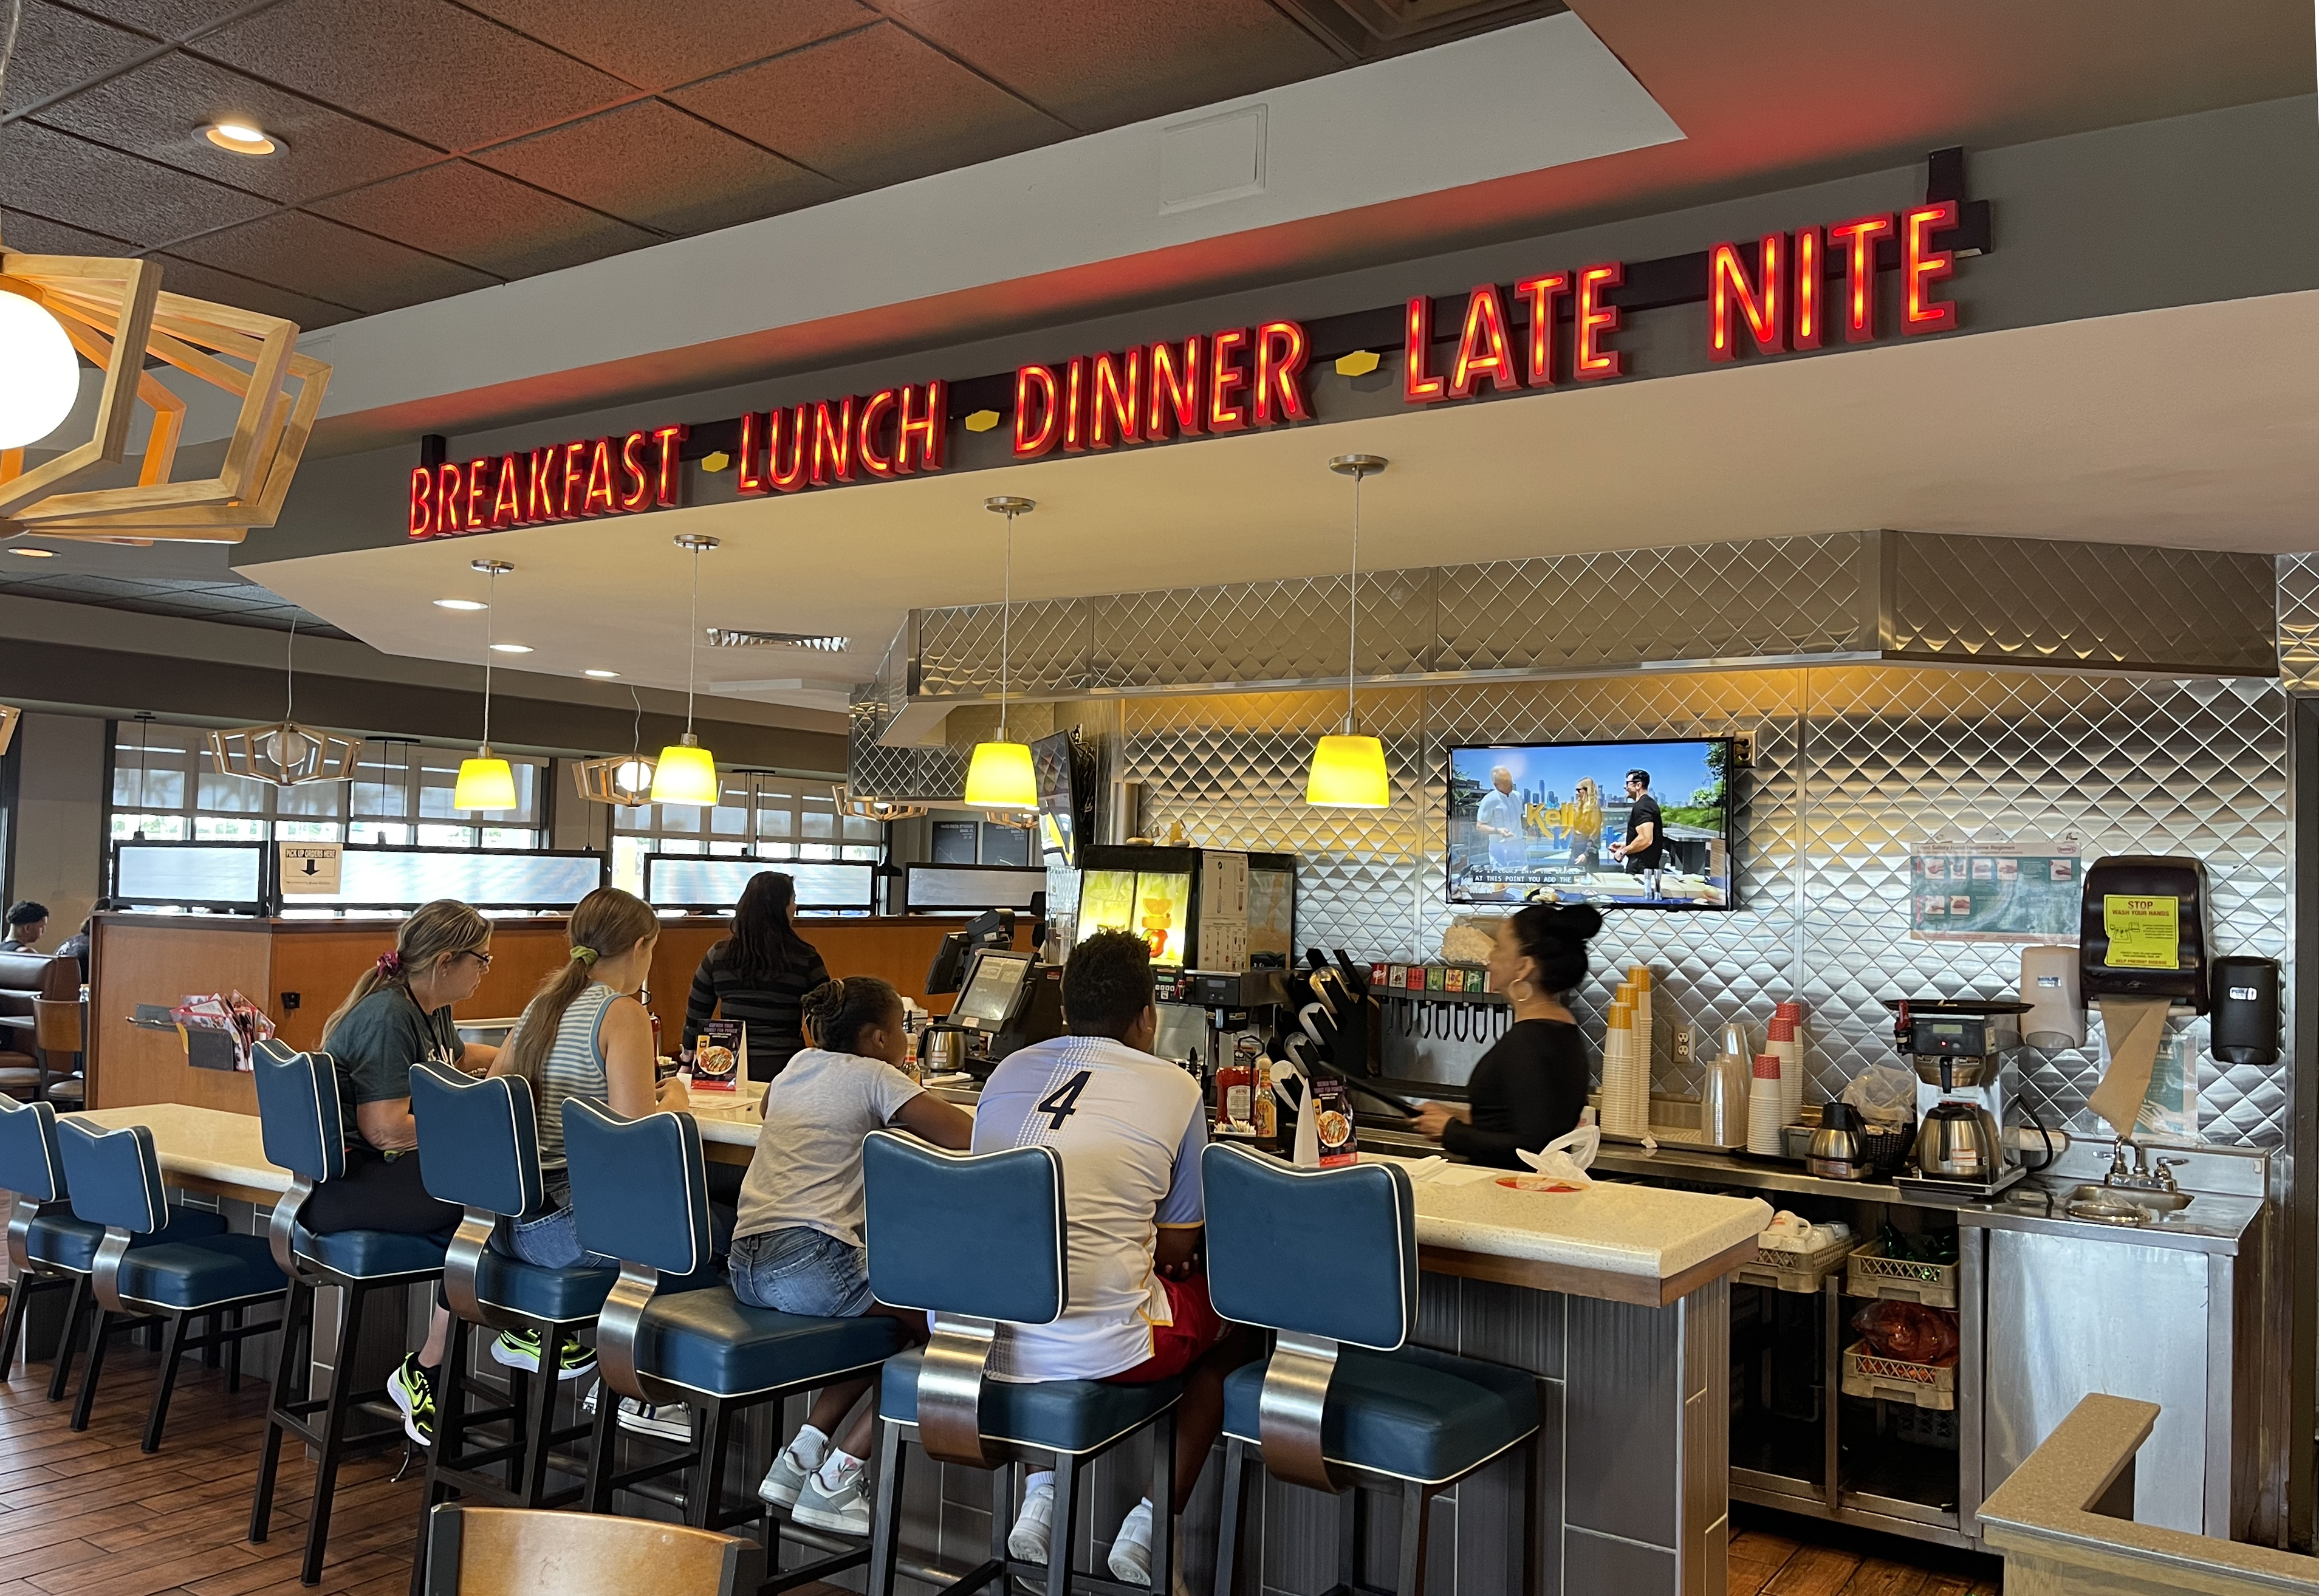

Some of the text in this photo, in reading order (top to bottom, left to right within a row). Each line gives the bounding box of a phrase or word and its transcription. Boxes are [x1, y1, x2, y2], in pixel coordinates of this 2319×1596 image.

[408, 199, 1959, 541] BREAKFAST LUNCH DINNER LATE NITE
[1527, 802, 1575, 833] Kell
[2128, 900, 2153, 909] STOP
[1037, 1070, 1092, 1131] 4
